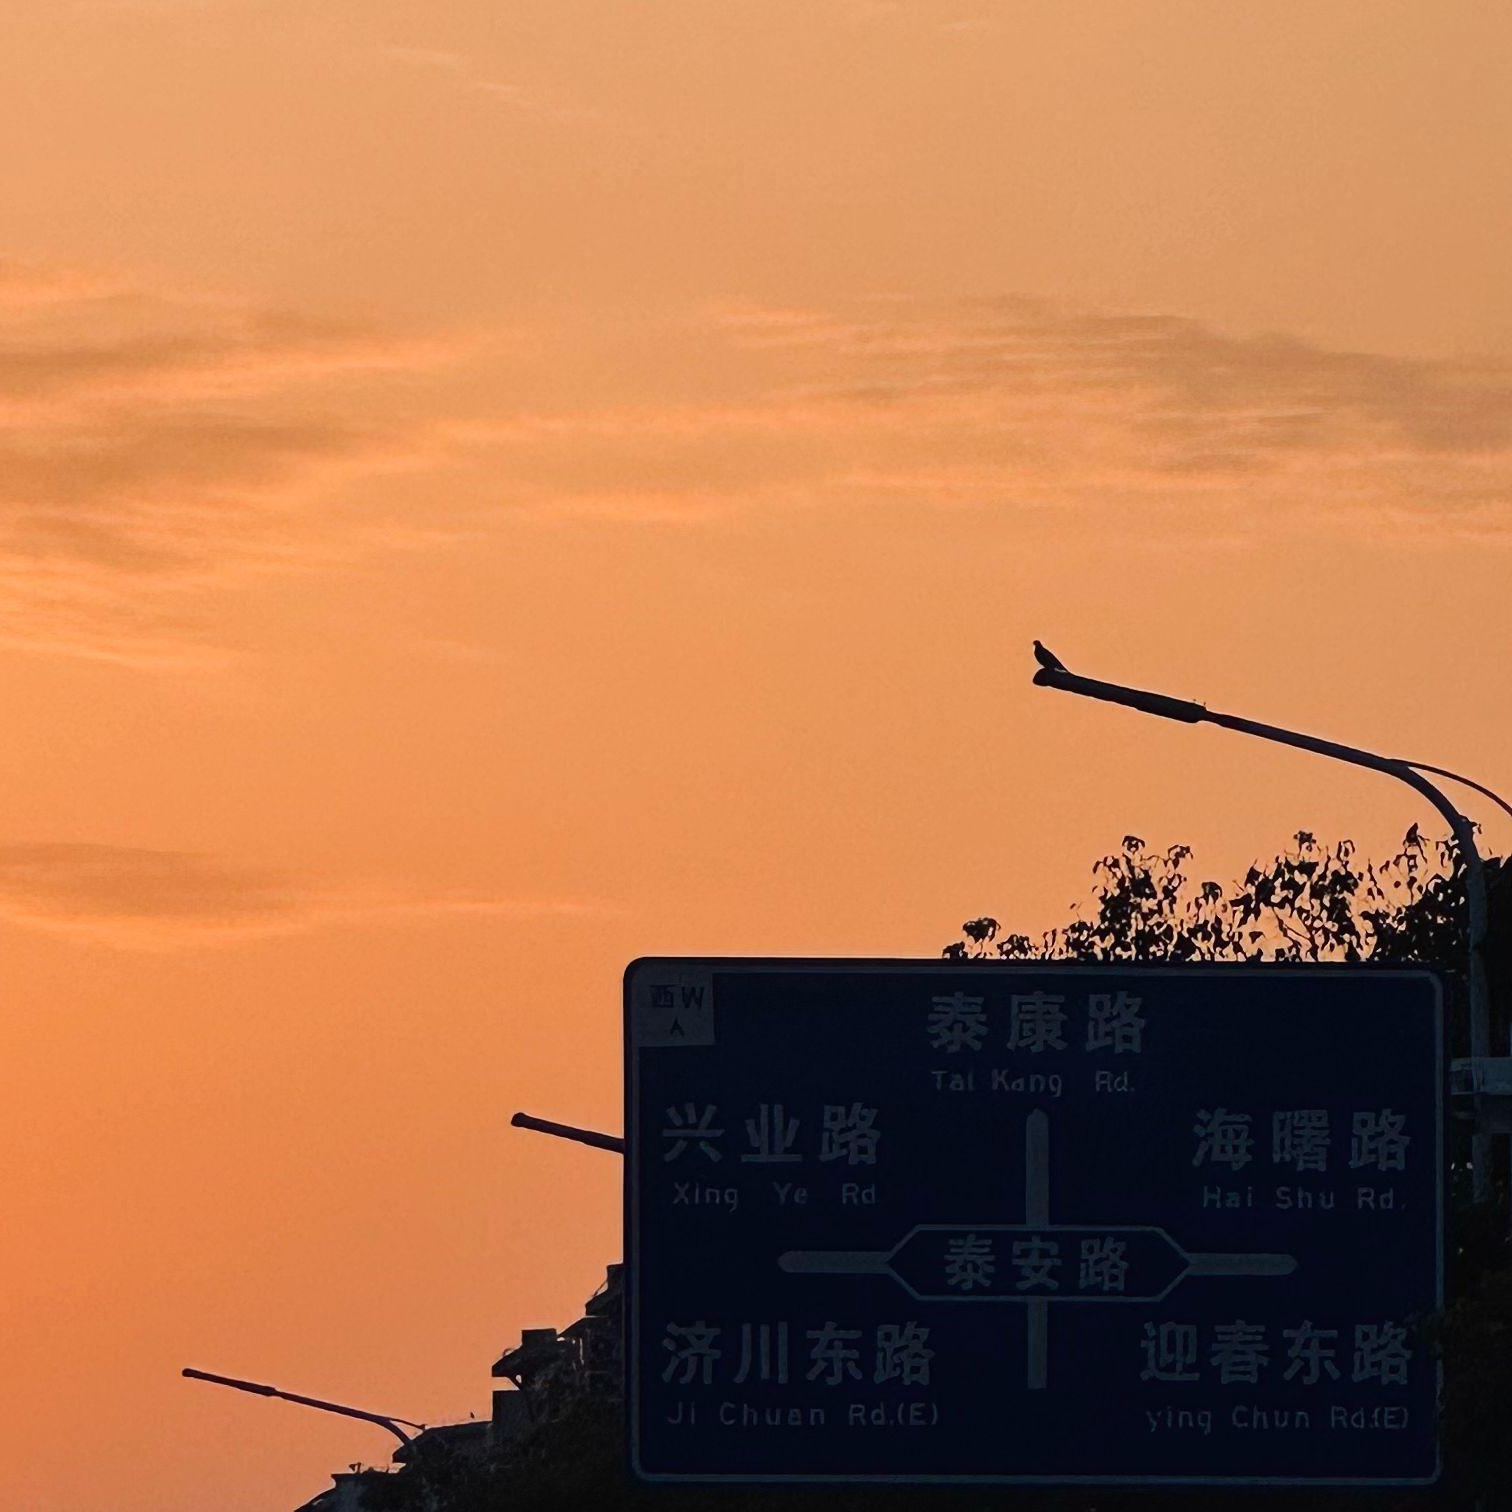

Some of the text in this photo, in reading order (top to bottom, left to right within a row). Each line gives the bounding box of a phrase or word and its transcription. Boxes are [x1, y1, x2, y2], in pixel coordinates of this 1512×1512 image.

[925, 988, 1147, 1055] 泰康路
[931, 1067, 1136, 1098] Tai Kang Rd.
[661, 1100, 881, 1165] 兴业路
[1190, 1105, 1413, 1172] 海曙路
[670, 1181, 739, 1213] Xing
[771, 1180, 809, 1205] Ye
[1201, 1185, 1408, 1210] Hai Shu Rd.
[942, 1233, 1130, 1292] 泰安路
[659, 1318, 936, 1386] 济川东路
[1138, 1318, 1413, 1386] 迎春东路
[665, 1399, 697, 1426] Ji
[718, 1400, 825, 1427] Chuan
[1230, 1403, 1311, 1430] Chun
